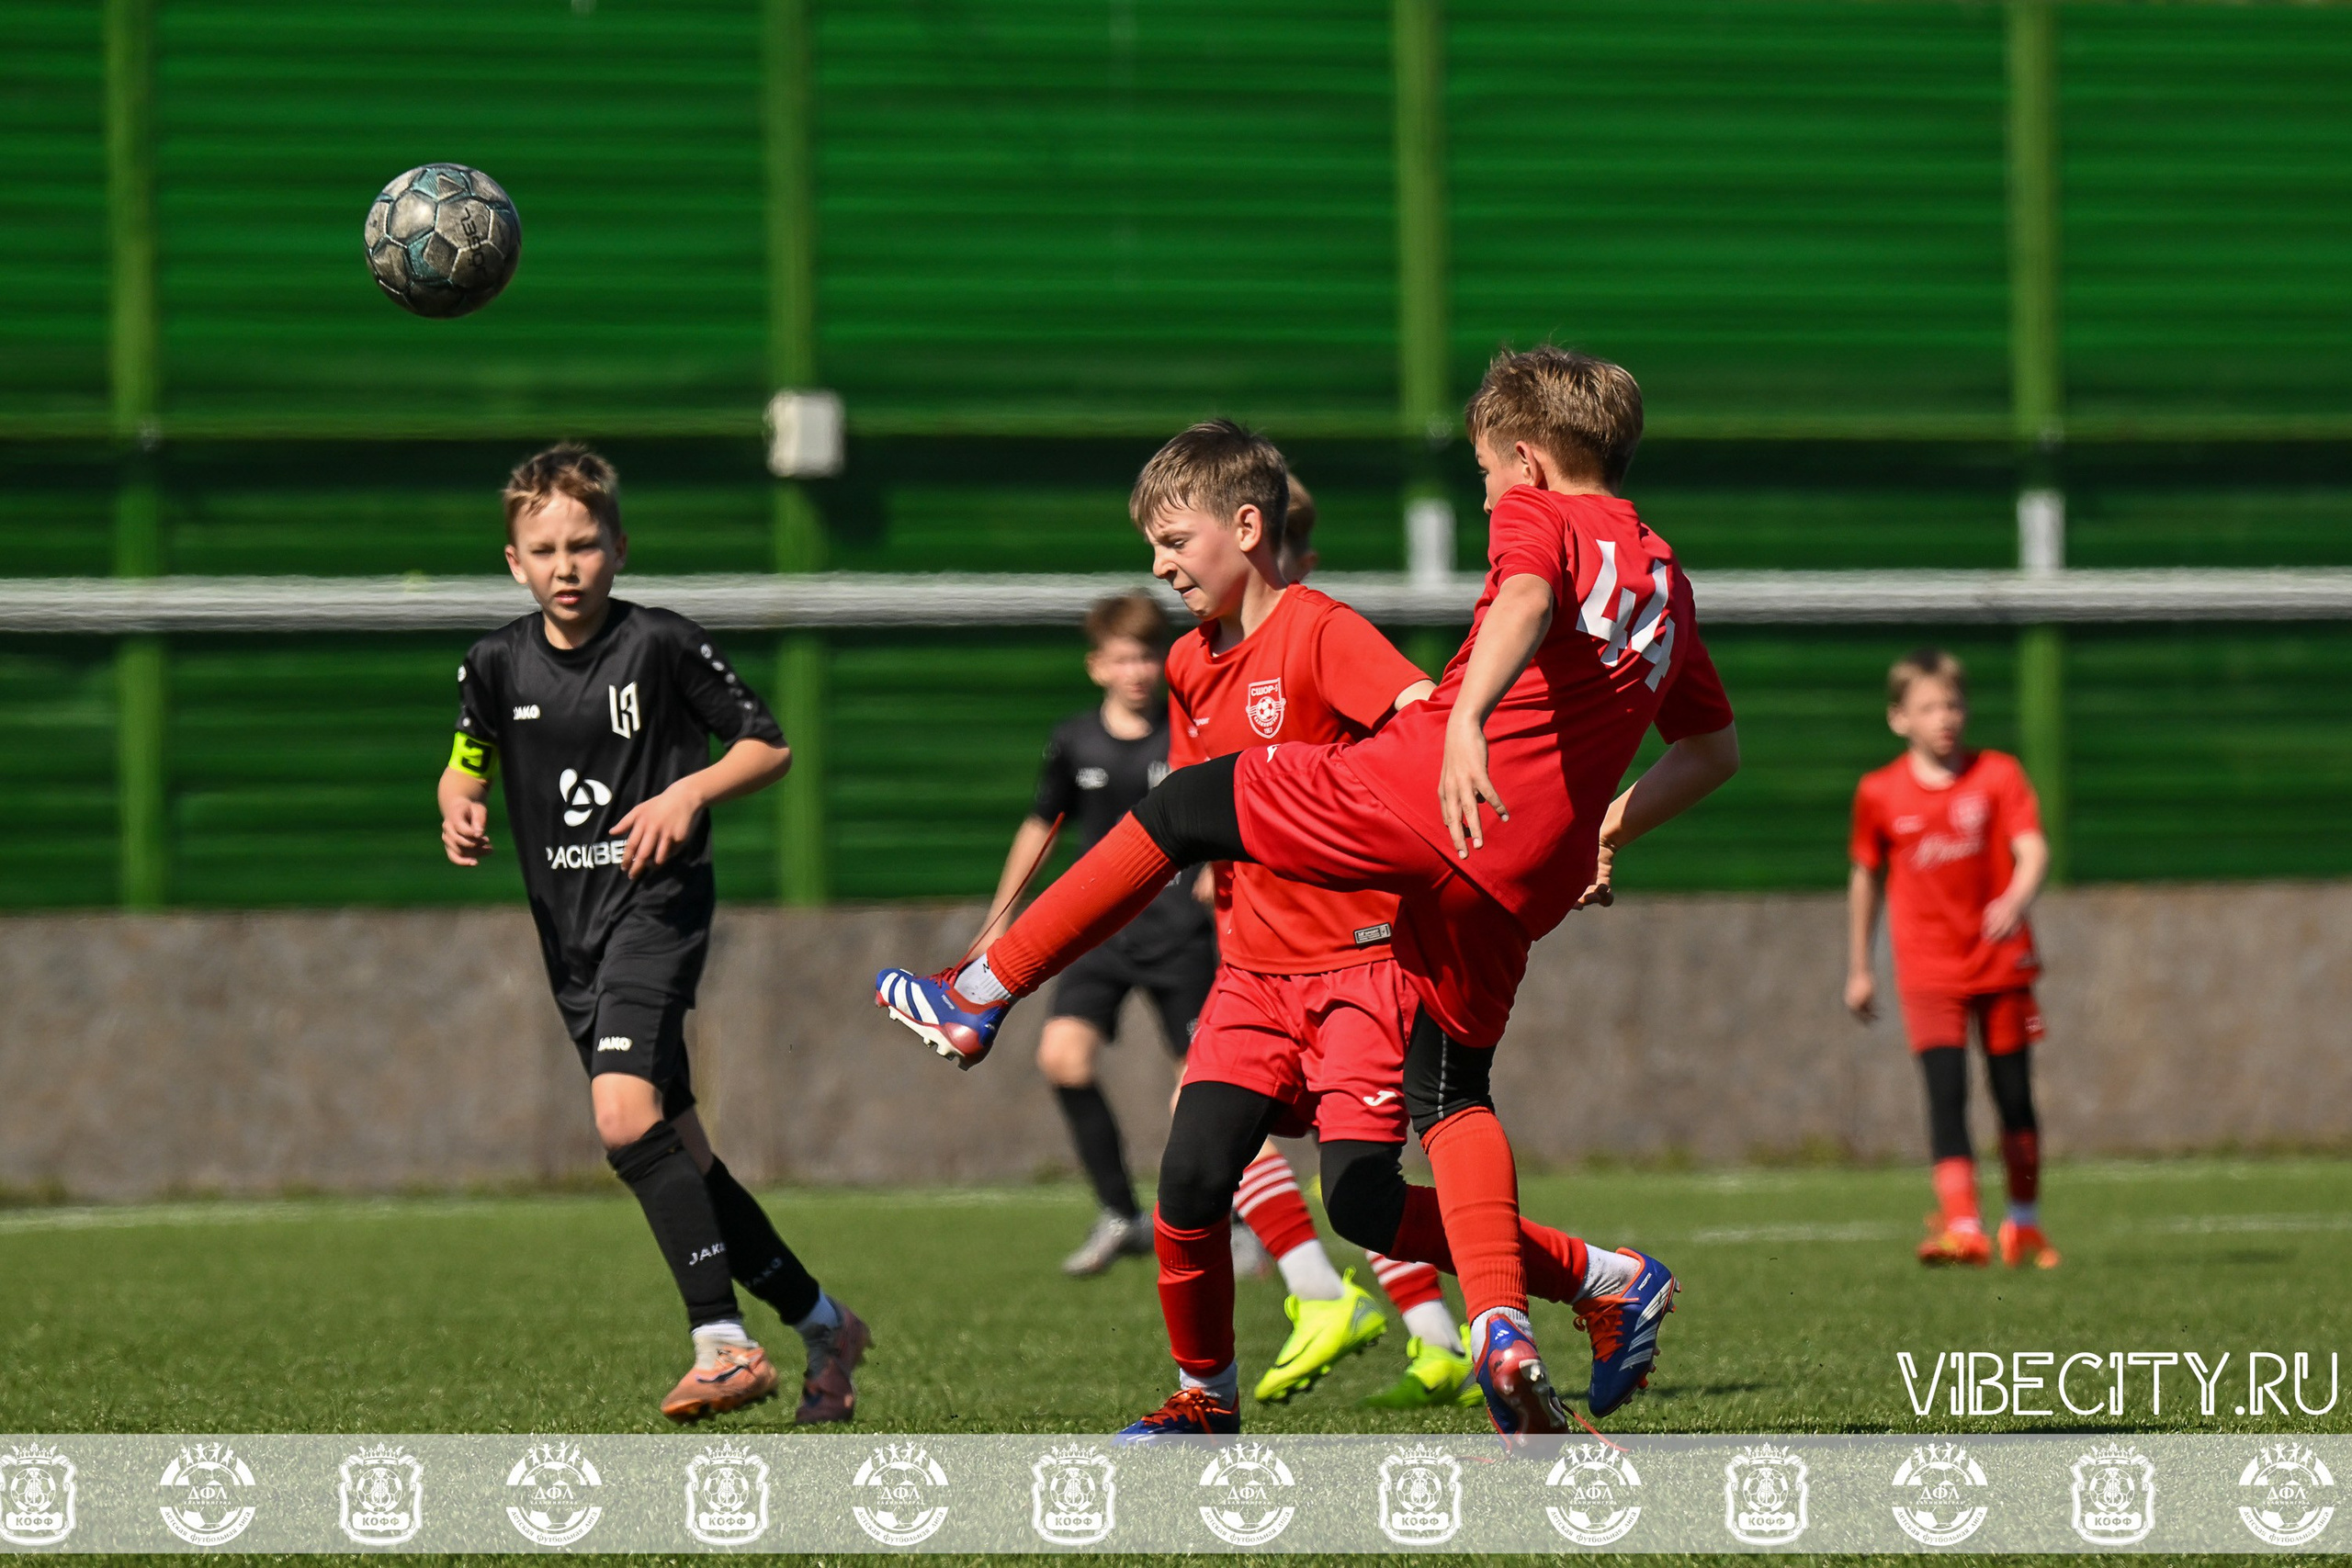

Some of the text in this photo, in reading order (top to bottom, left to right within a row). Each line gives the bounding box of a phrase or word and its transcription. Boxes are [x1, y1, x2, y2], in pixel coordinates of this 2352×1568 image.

[1576, 538, 1676, 694] 44
[513, 704, 541, 721] JAKO
[597, 1036, 633, 1052] JAKO
